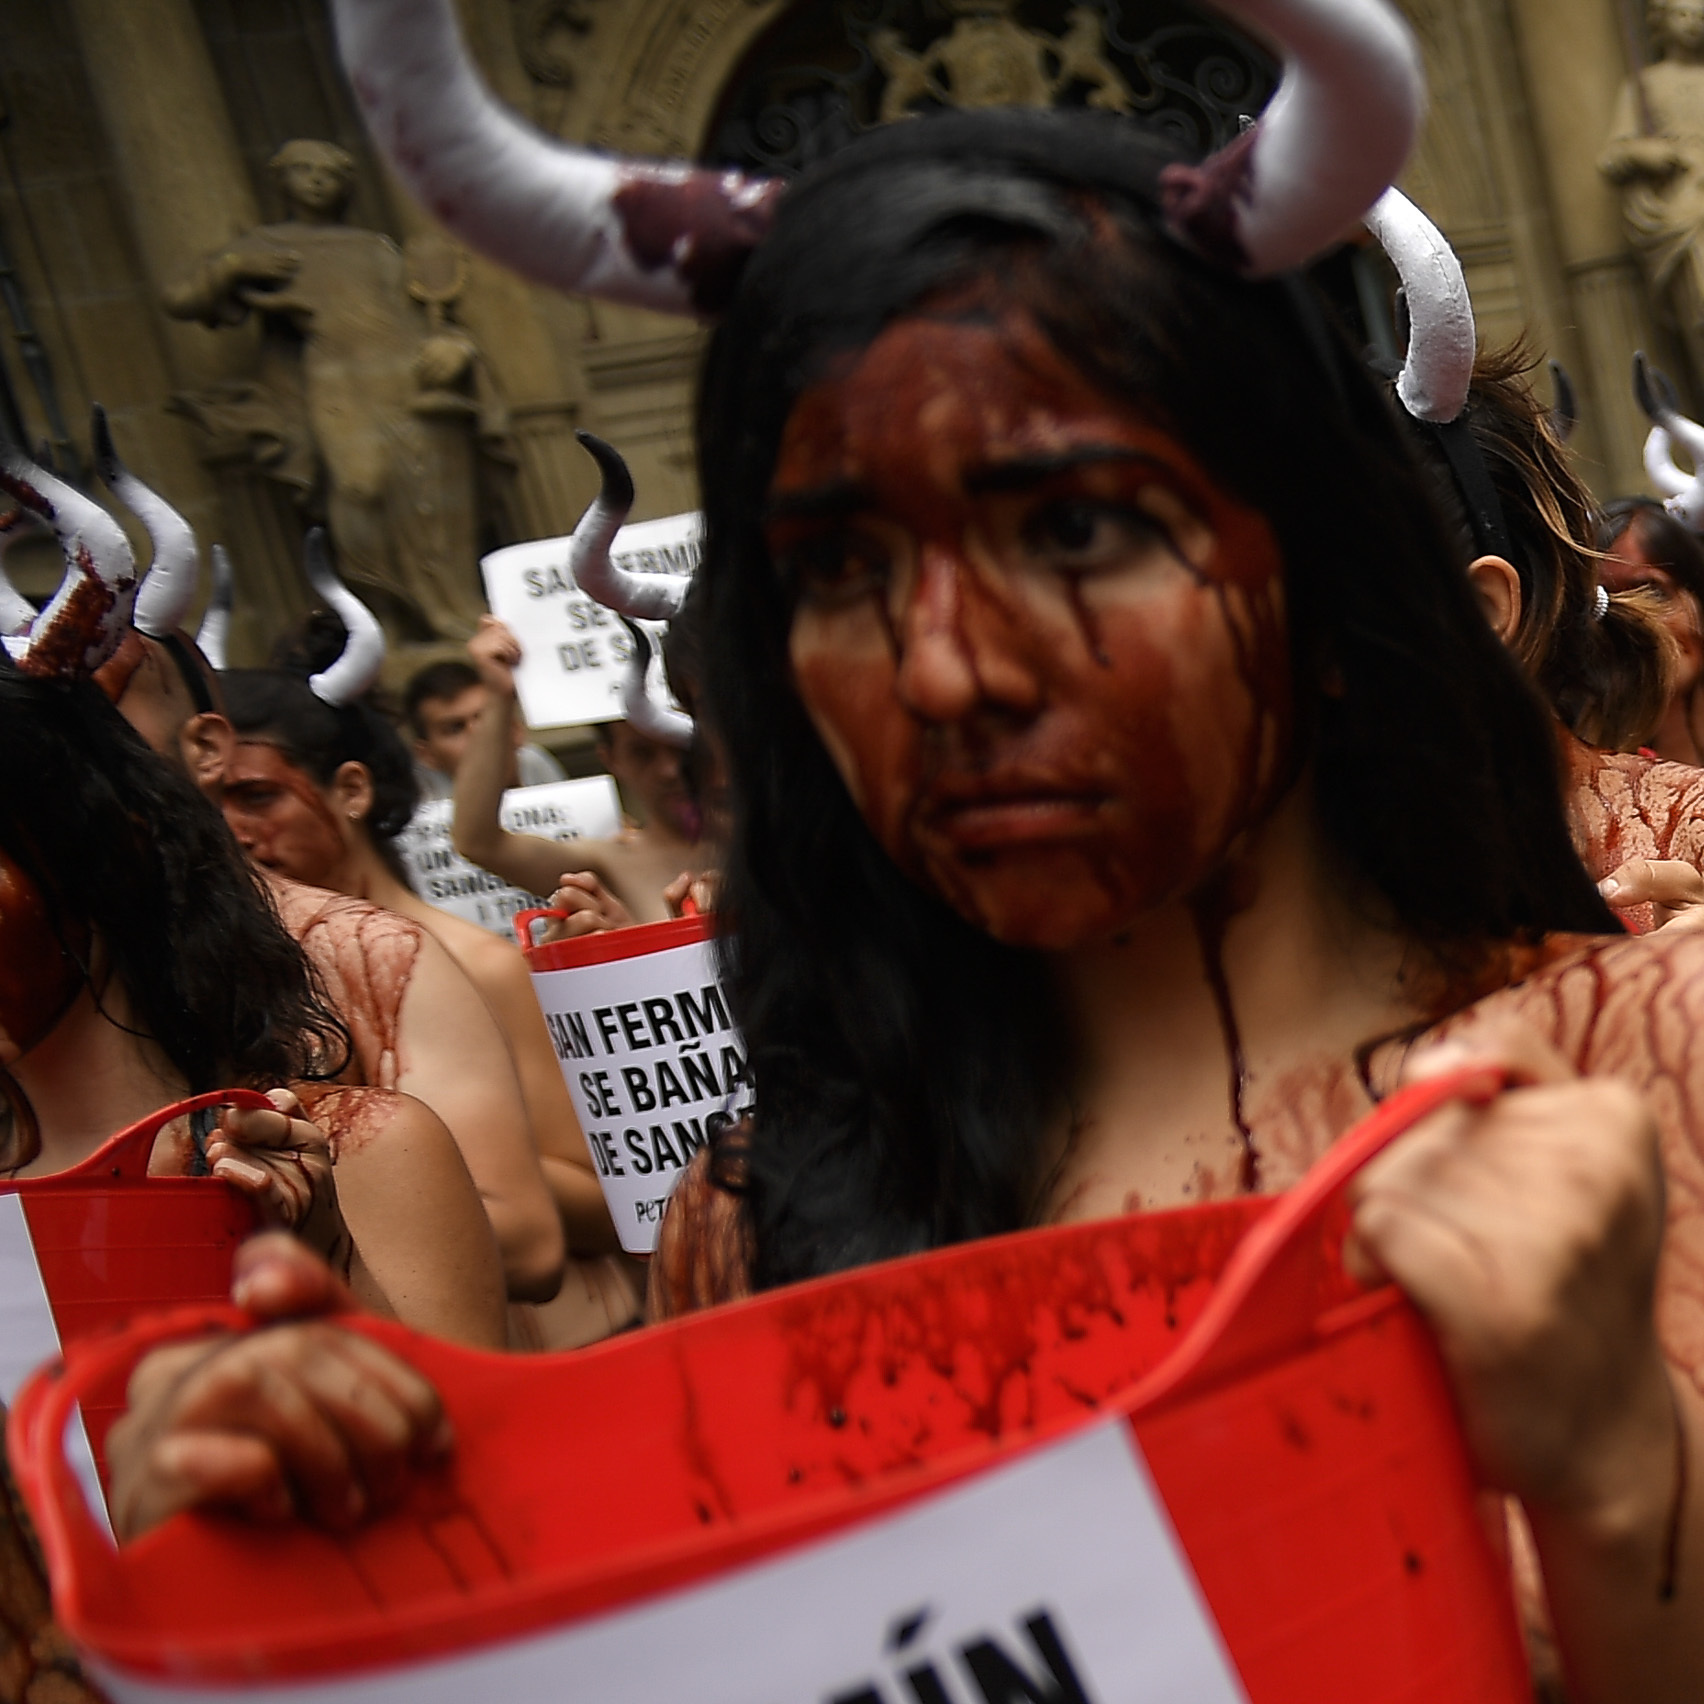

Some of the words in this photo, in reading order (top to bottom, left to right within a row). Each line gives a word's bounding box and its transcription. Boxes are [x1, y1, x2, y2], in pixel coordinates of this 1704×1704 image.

[558, 639, 603, 671] DE
[579, 1069, 622, 1119] SE
[620, 1041, 754, 1113] BAÑA
[589, 1132, 625, 1176] DE
